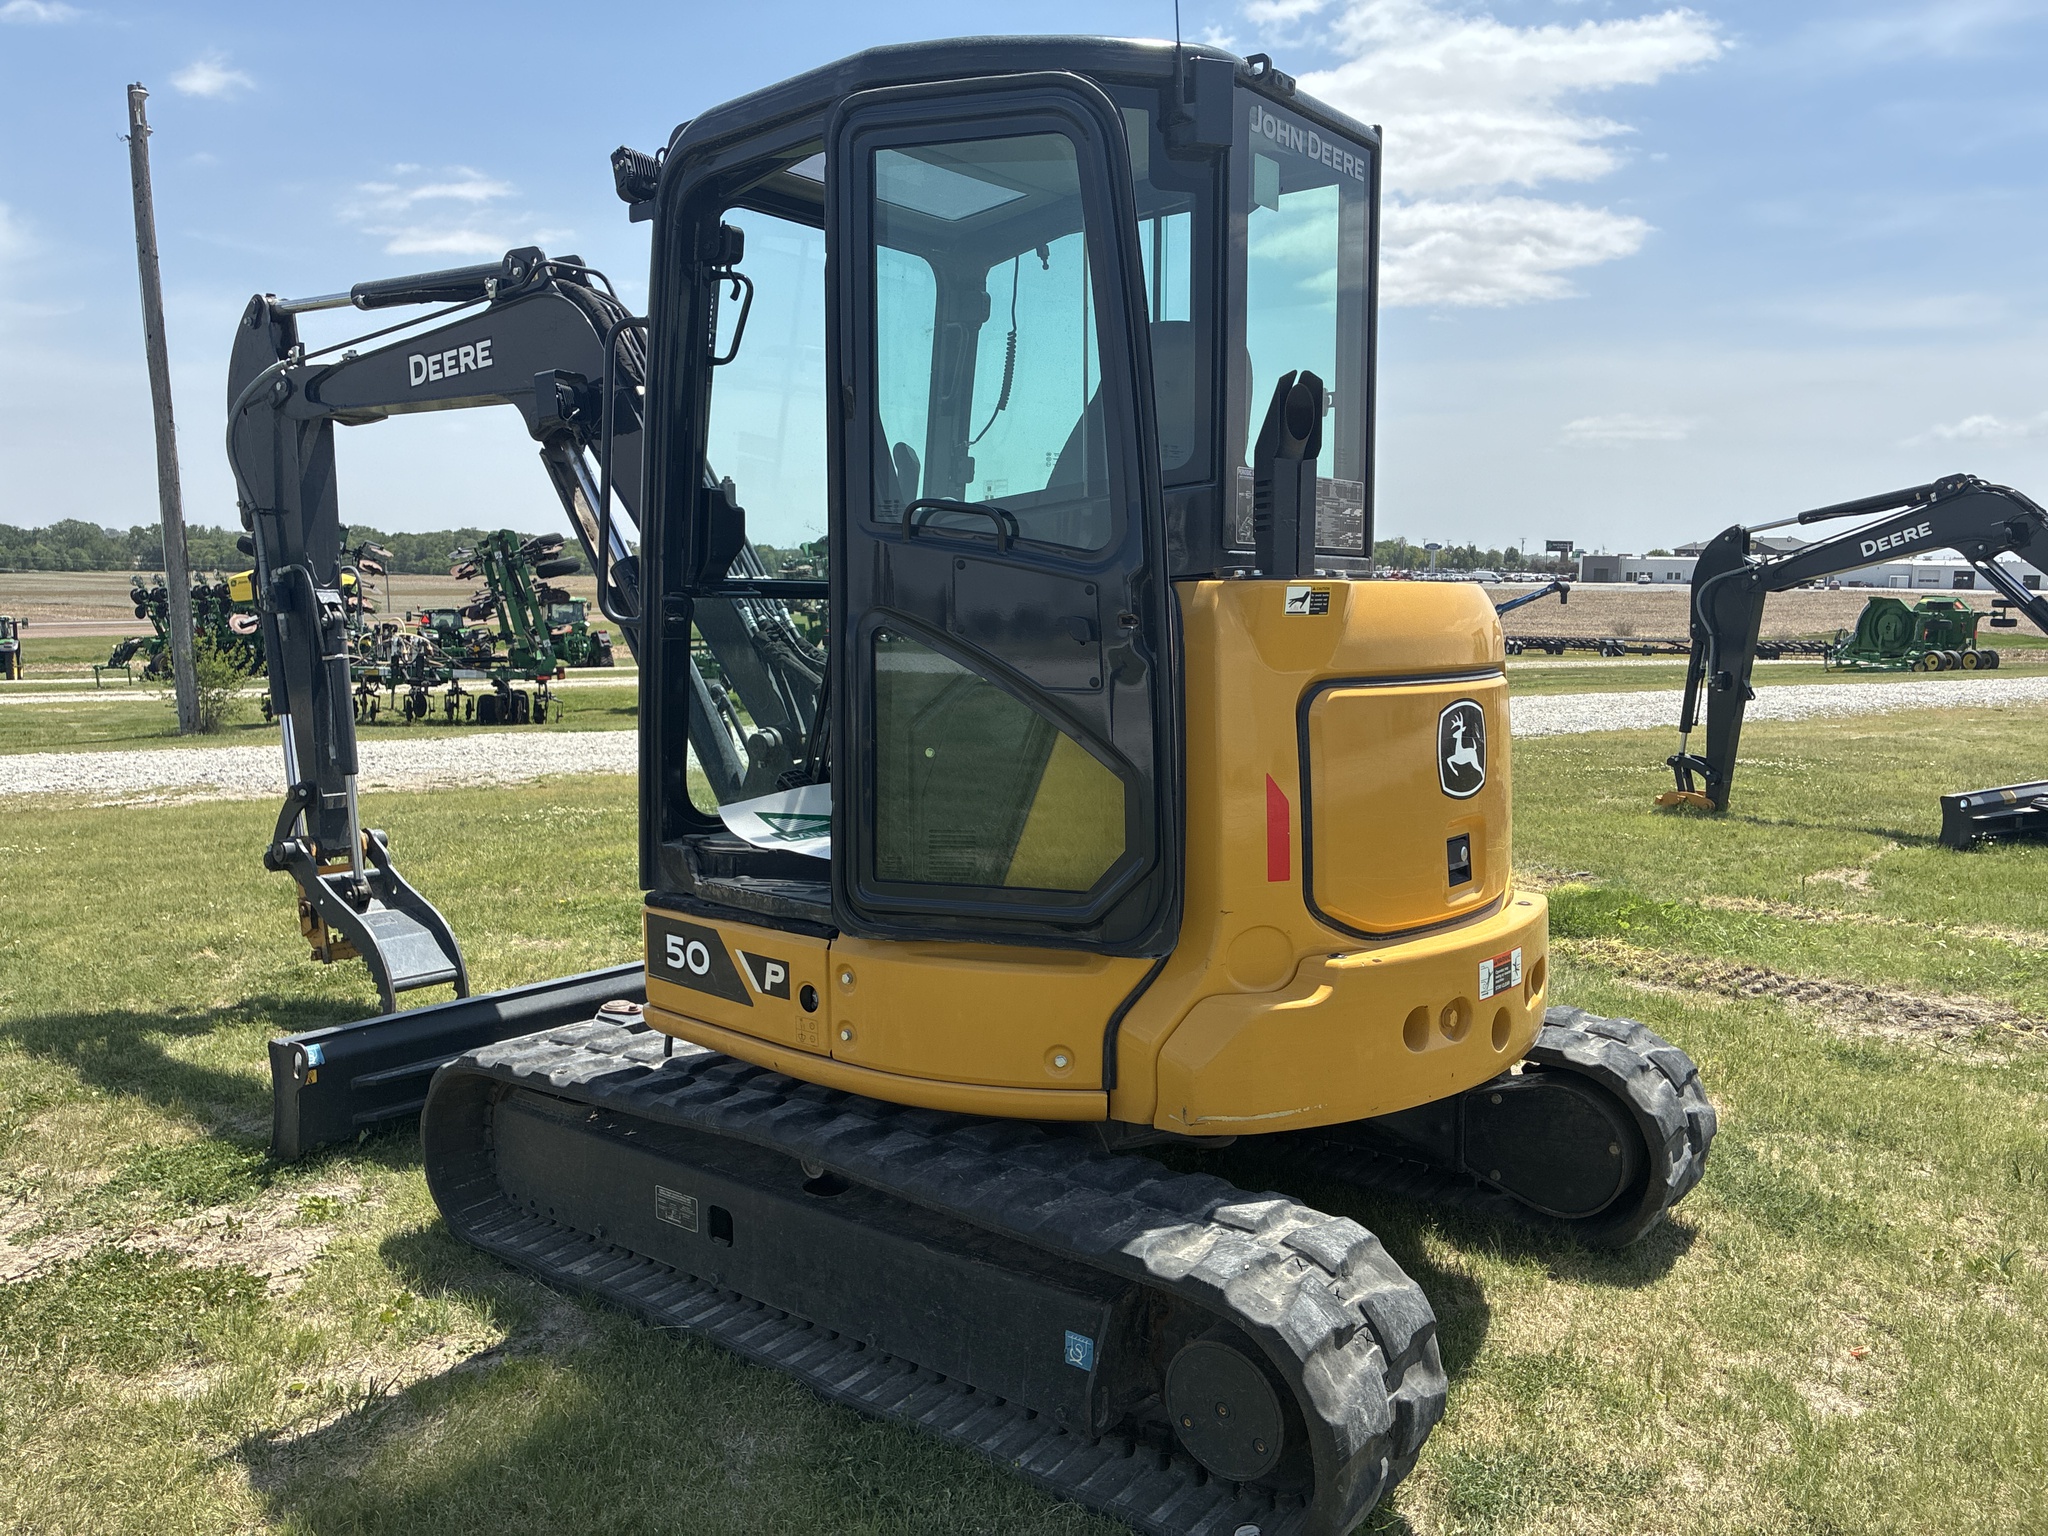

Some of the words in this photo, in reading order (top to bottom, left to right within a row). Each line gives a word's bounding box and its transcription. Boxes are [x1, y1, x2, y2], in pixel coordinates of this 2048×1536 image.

[1251, 105, 1303, 153] JOHN
[1308, 130, 1365, 182] DEERE
[408, 339, 493, 387] DEERE
[1860, 521, 1933, 558] DEERE
[666, 933, 710, 976] 50
[764, 962, 785, 991] P
